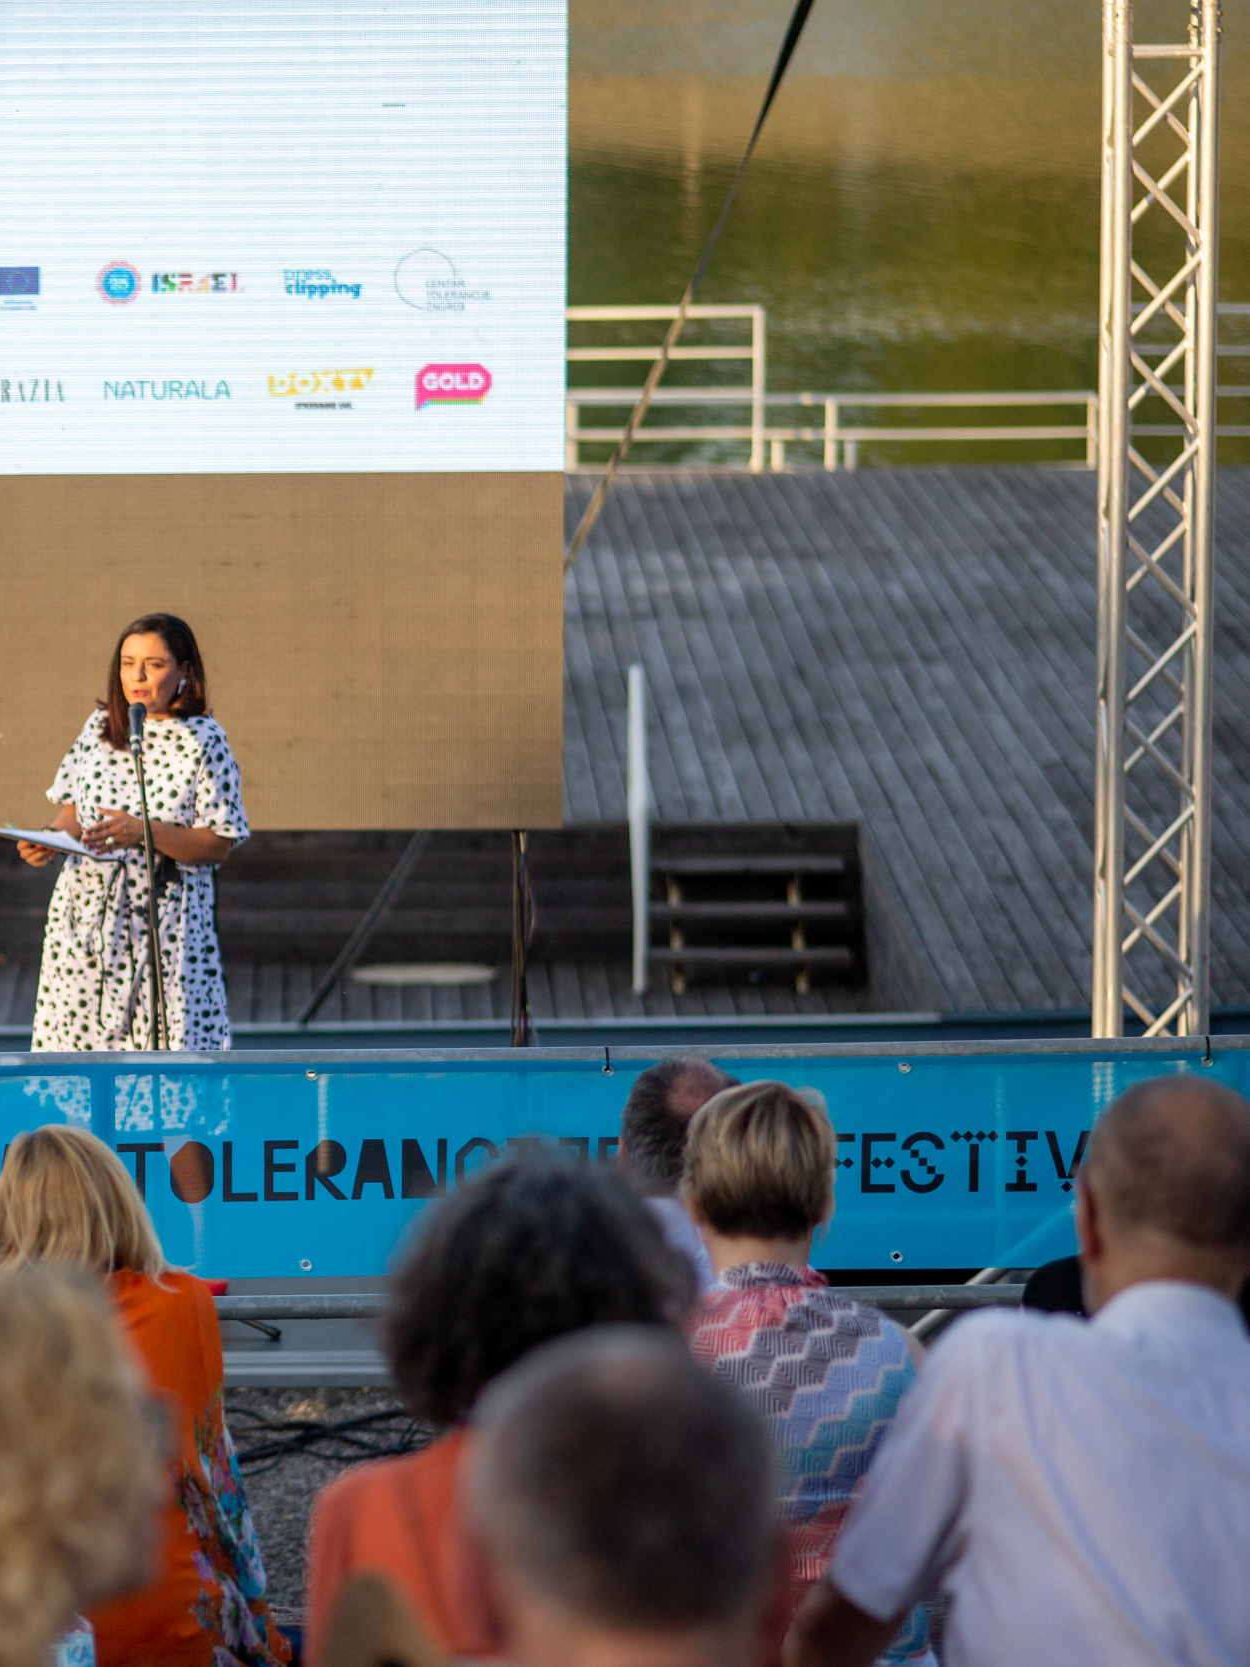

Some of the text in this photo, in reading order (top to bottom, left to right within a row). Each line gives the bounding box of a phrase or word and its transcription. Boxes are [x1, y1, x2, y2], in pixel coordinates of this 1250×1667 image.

[152, 272, 245, 294] ISRAEL
[284, 279, 362, 299] clipping
[104, 380, 232, 400] NATURALA
[422, 371, 486, 391] GOLD
[116, 1137, 623, 1204] TOLERANC
